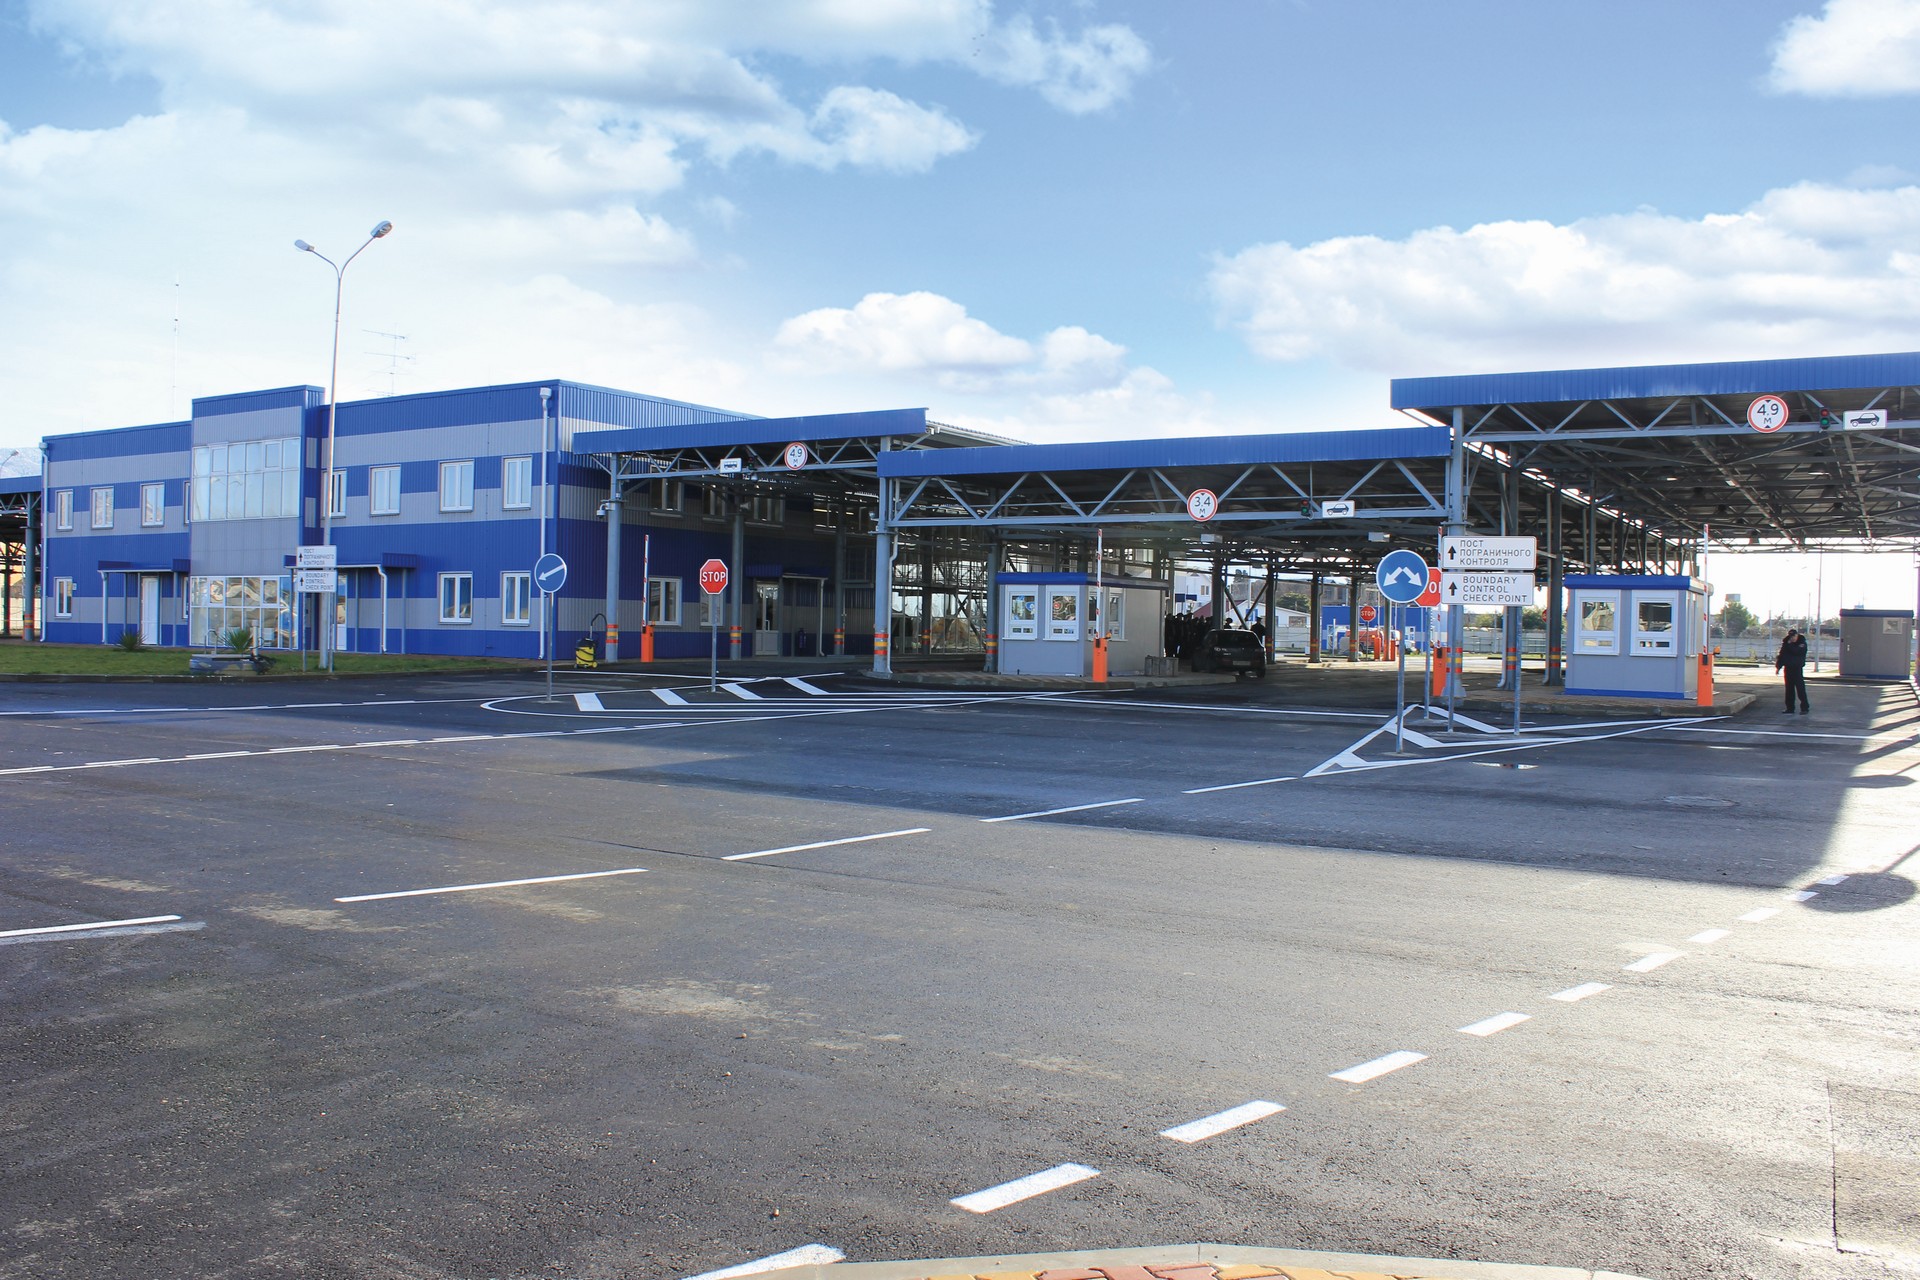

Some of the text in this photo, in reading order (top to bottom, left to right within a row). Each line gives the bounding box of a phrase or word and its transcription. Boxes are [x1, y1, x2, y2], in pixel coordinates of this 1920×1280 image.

[1460, 549, 1531, 557] ПОГРАНИЧНОГО
[1460, 558, 1509, 566] КОНТРОЛЯ
[702, 571, 726, 582] STOP
[1462, 576, 1518, 584] BOUNDARY
[1462, 585, 1509, 593] CONTROL
[1462, 594, 1494, 602] CHECK
